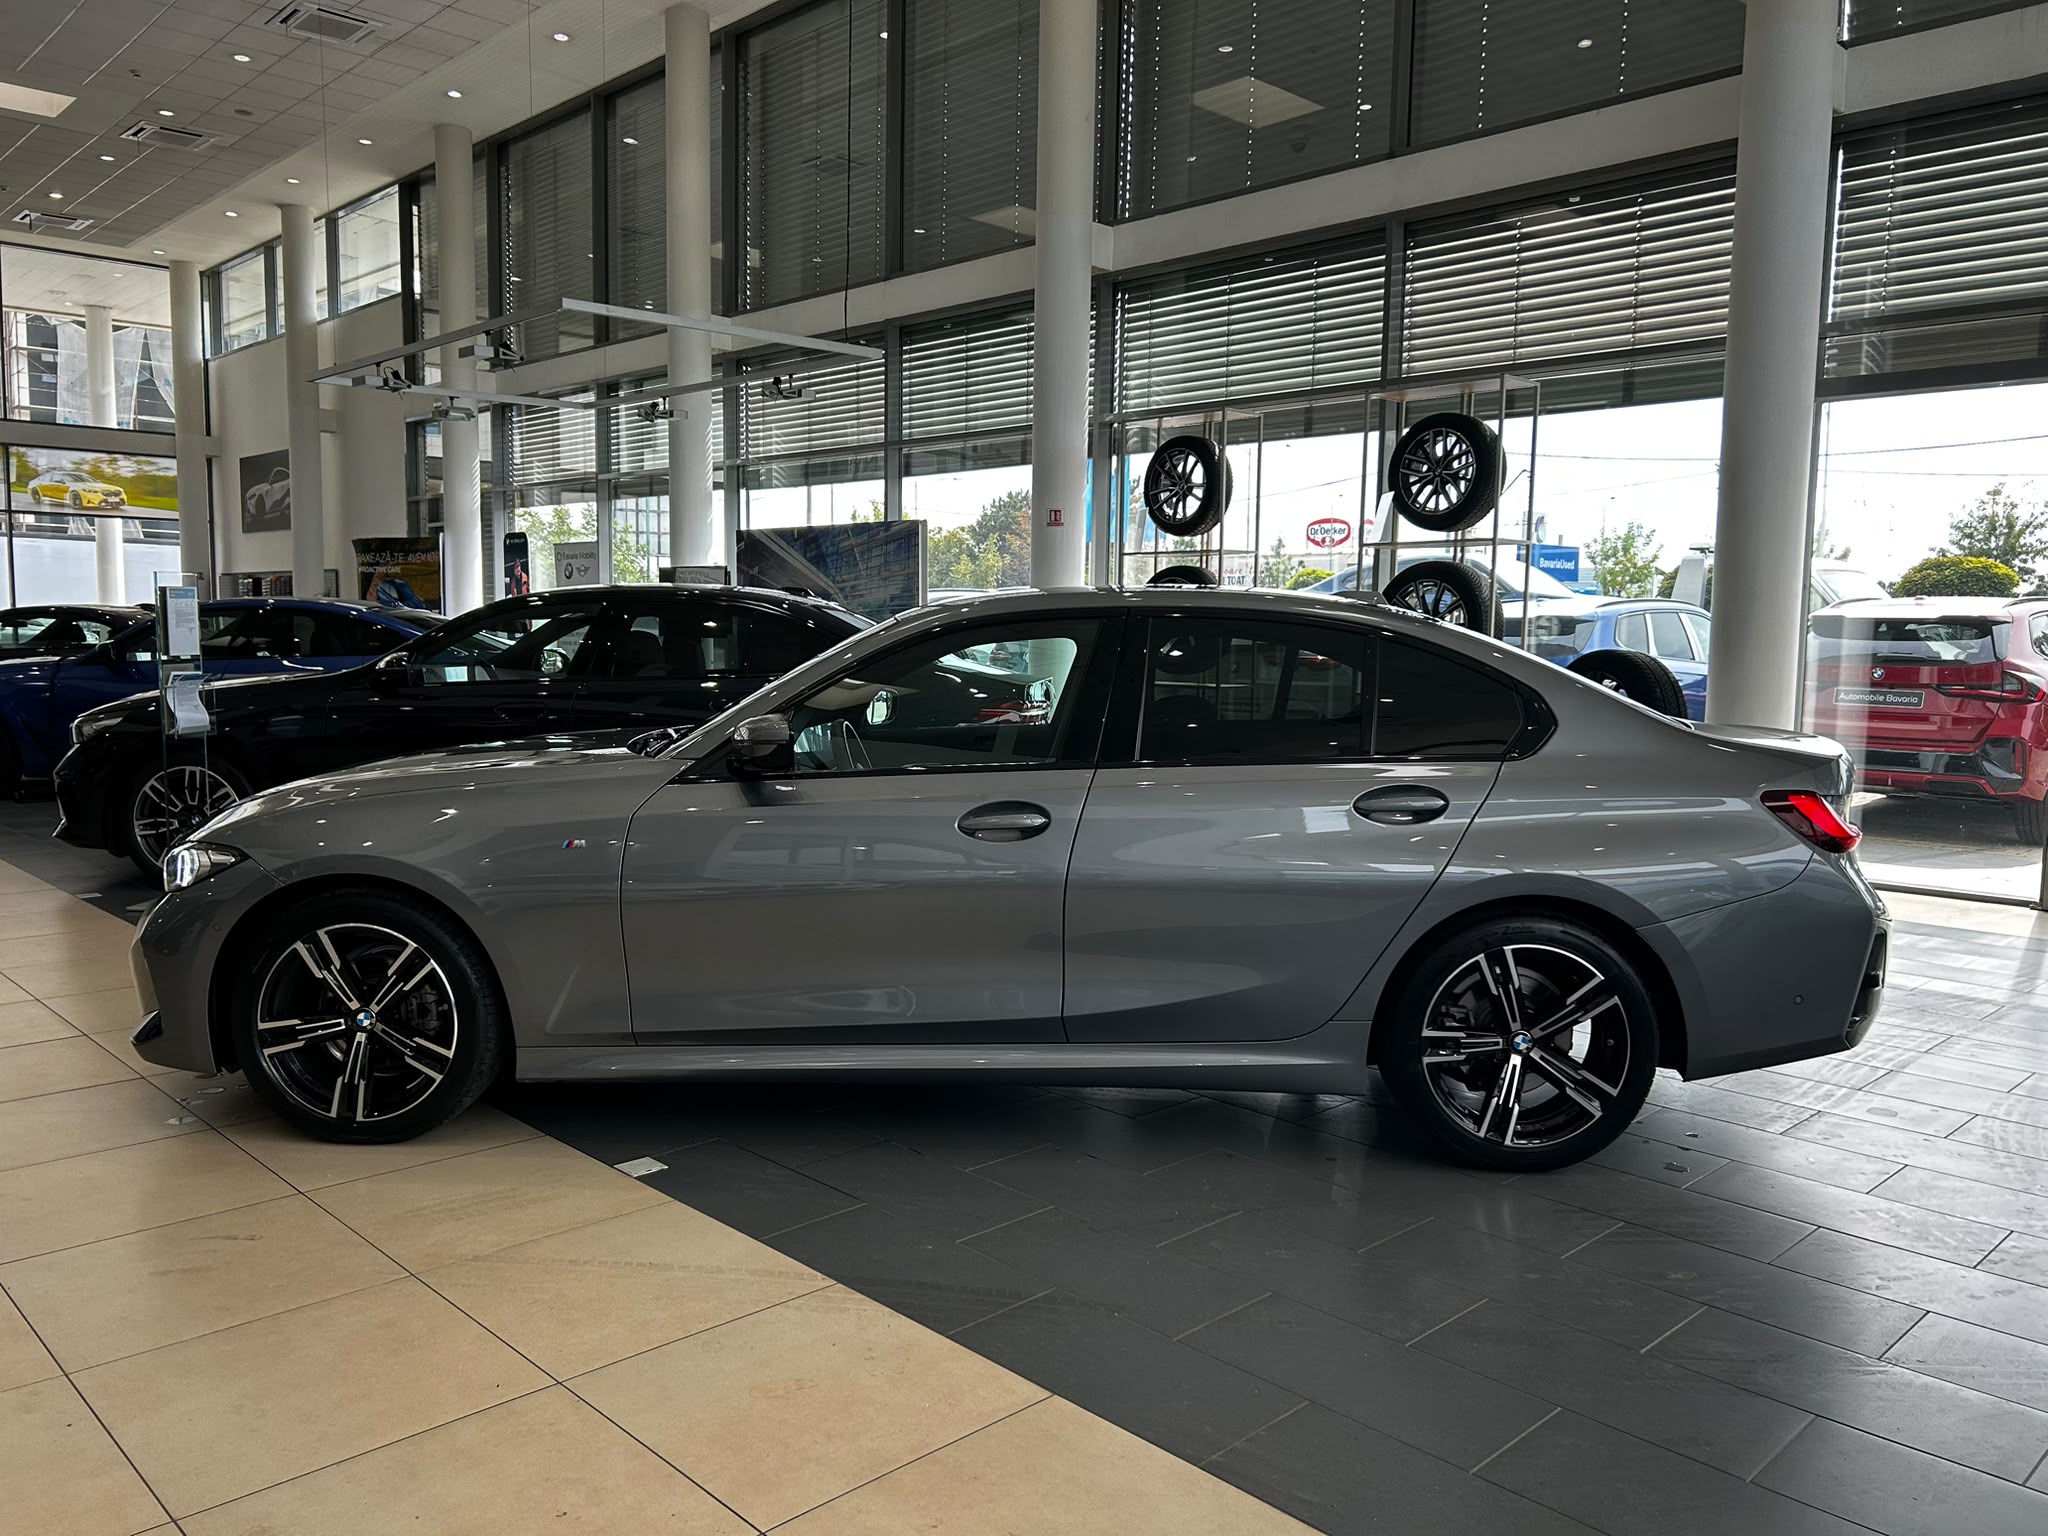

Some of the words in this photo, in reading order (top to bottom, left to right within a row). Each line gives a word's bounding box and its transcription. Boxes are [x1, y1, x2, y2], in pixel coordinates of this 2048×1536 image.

[1540, 557, 1575, 569] BavariaUsed
[1838, 692, 1885, 702] Automobile
[1886, 694, 1919, 703] Bavaria
